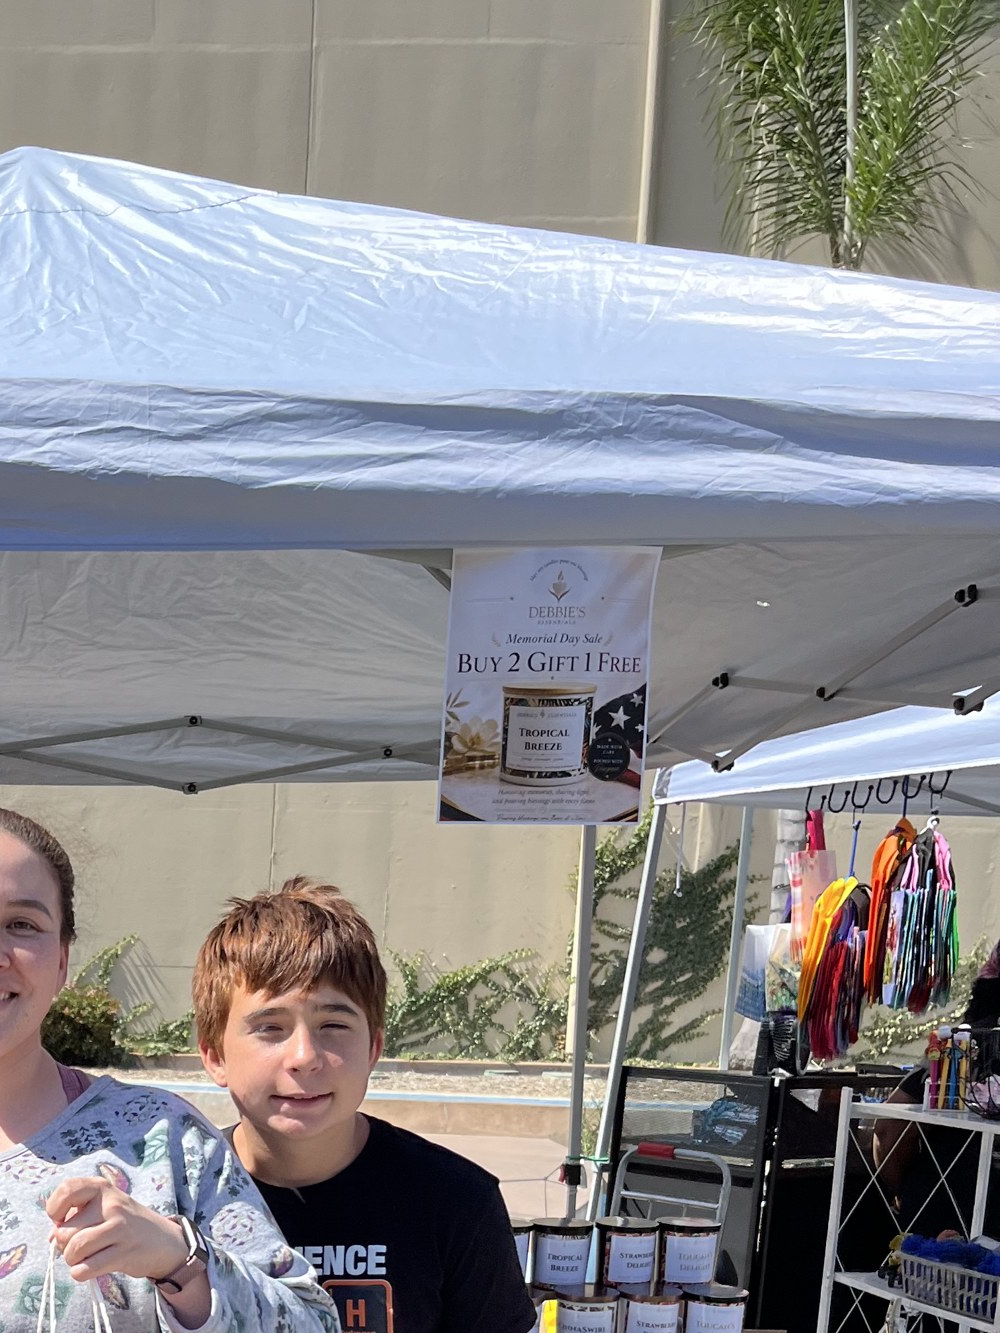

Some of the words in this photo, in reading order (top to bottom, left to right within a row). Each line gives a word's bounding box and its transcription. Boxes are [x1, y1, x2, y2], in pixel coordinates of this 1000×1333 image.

[529, 606, 587, 619] DEBBIE'S
[505, 632, 557, 645] Memorial
[559, 632, 581, 647] Day
[582, 633, 603, 644] Sale
[457, 653, 503, 673] BUY
[507, 651, 521, 673] 2
[527, 651, 580, 673] GIFT
[584, 652, 592, 672] 1
[597, 652, 642, 673] FREE
[518, 727, 571, 738] TROPICAL
[523, 741, 563, 751] BREEZE
[296, 1245, 387, 1276] ENCE
[550, 1264, 579, 1272] BREEZE
[346, 1299, 366, 1327] H
